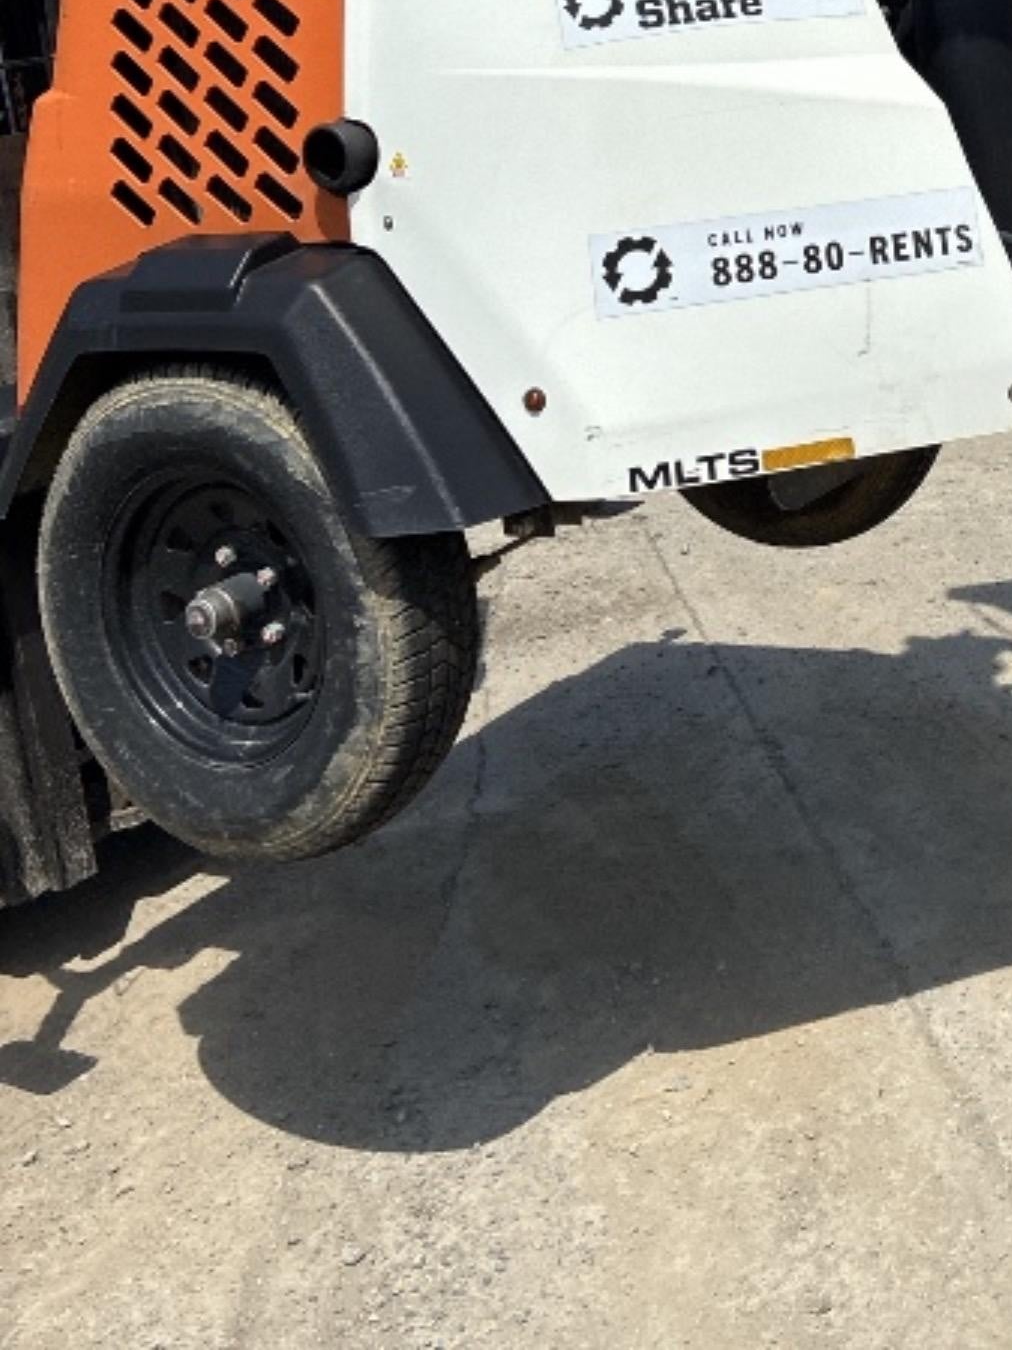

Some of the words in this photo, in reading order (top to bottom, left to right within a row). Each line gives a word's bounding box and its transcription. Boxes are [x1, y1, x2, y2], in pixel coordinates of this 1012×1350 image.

[707, 230, 754, 247] CALL
[764, 222, 805, 240] NOW
[711, 224, 974, 286] 888-80-RENTS
[628, 449, 760, 492] MLTS
